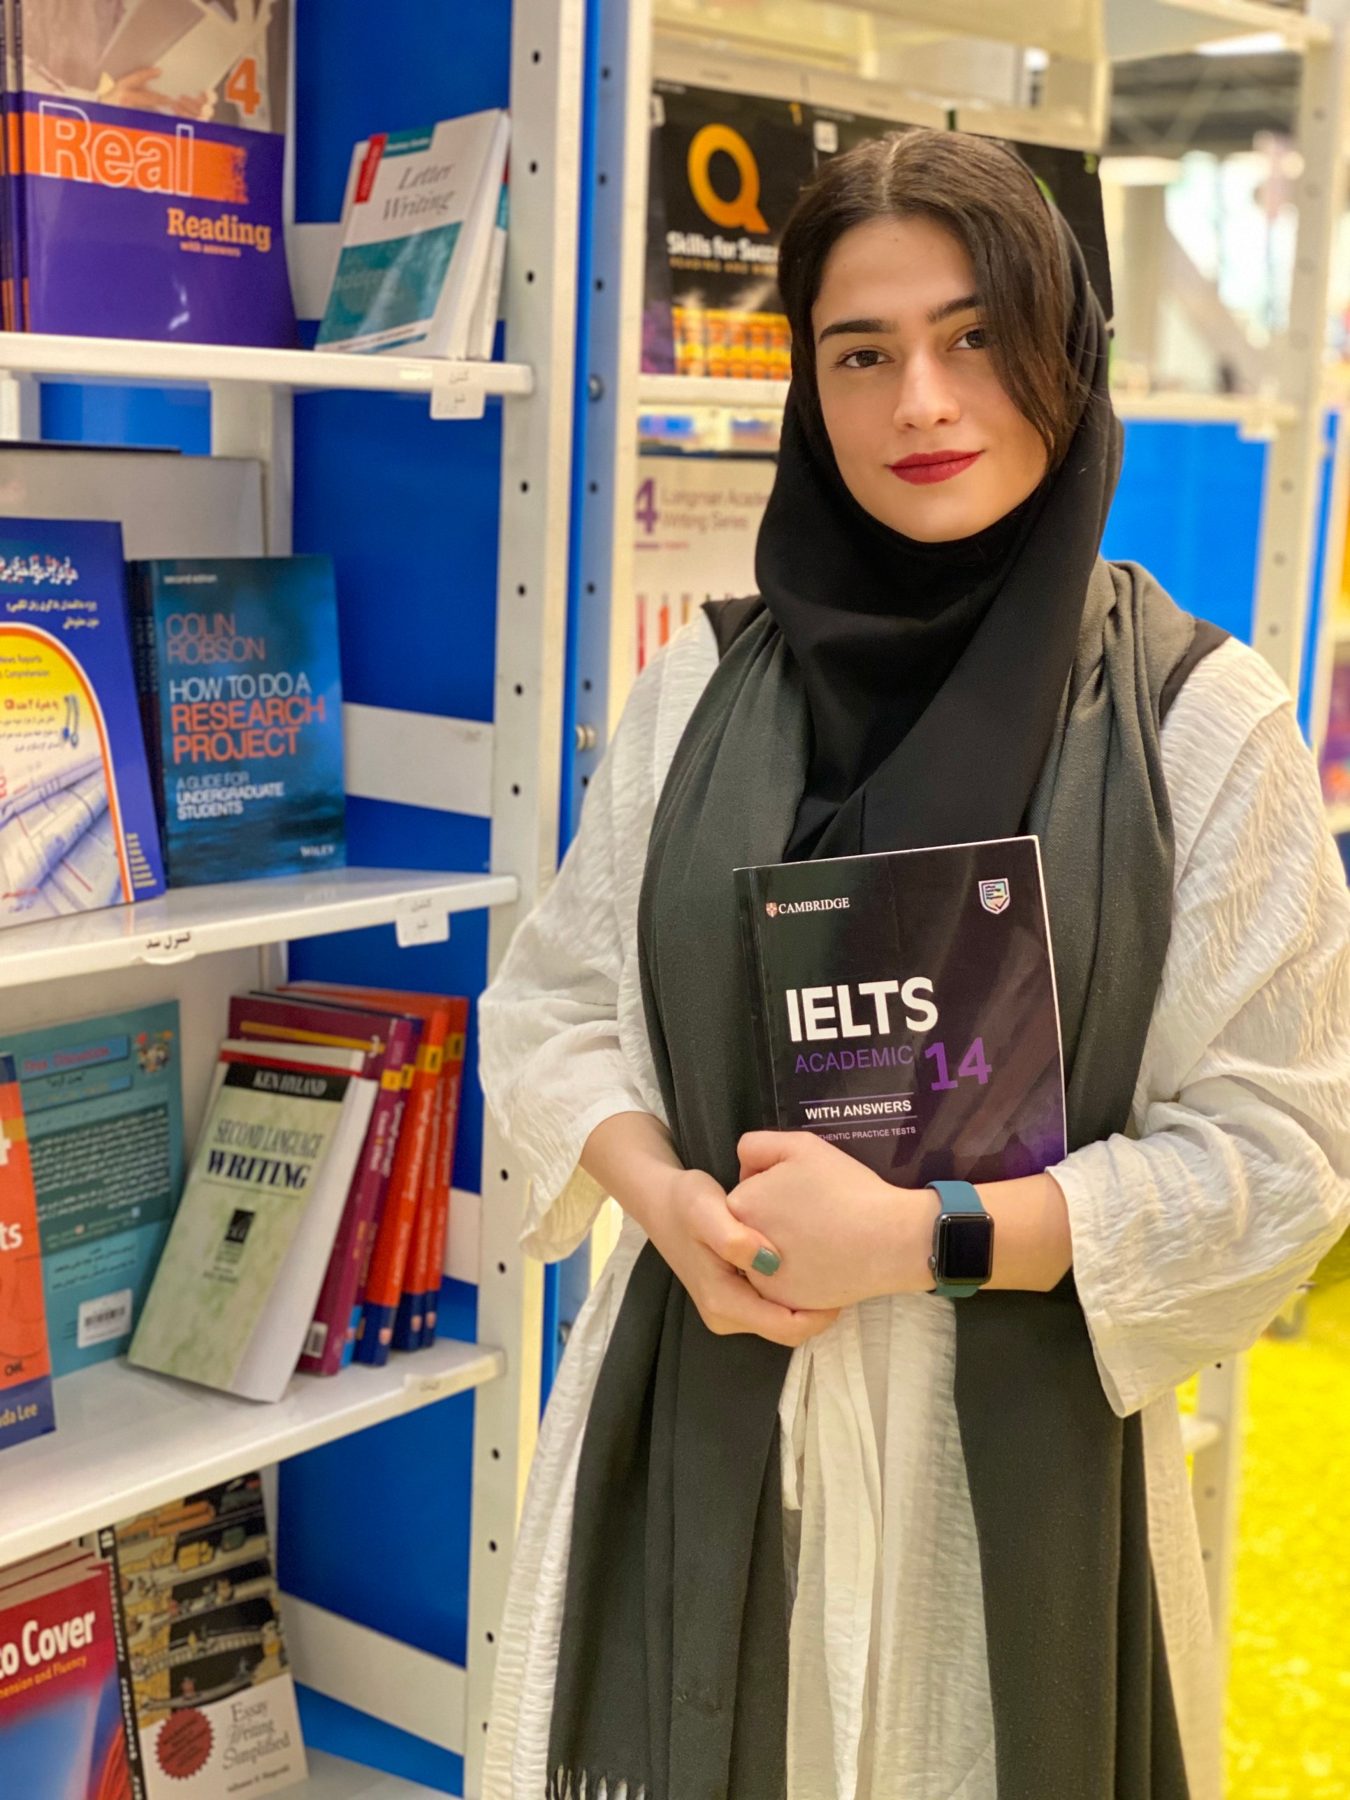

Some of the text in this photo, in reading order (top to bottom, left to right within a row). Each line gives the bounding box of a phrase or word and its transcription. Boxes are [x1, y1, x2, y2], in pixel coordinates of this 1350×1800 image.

[225, 57, 262, 117] 4
[38, 100, 195, 198] Real
[398, 163, 455, 190] Letter
[686, 122, 769, 233] Q
[382, 190, 455, 220] Writing
[166, 206, 272, 253] Reading
[666, 230, 712, 258] Skills
[712, 235, 737, 259] for
[633, 476, 660, 534] 4
[165, 611, 237, 640] COLIN
[166, 635, 267, 665] ROBSON
[168, 670, 312, 703] HOW TO DO A
[170, 694, 326, 734] RESEARCH
[172, 725, 301, 765] PROJECT
[175, 781, 285, 804] UNDERGRADUATE
[186, 773, 223, 789] GUIDE
[223, 770, 250, 787] FOR
[176, 799, 245, 821] STUDENTS
[777, 896, 851, 915] CAMBRIDGE
[785, 976, 939, 1042] IELTS
[794, 1045, 914, 1074] ACADEMIC
[924, 1036, 993, 1092] 14
[252, 1069, 327, 1096] KEN HYLAND
[805, 1099, 913, 1120] WITH ANSWERS
[213, 1118, 324, 1158] SECOND LANGUAGE
[852, 1128, 890, 1140] PRACTICE
[891, 1125, 917, 1137] TESTS
[206, 1148, 312, 1190] WRITING
[17, 1402, 37, 1422] Lee
[22, 1610, 96, 1667] Cover
